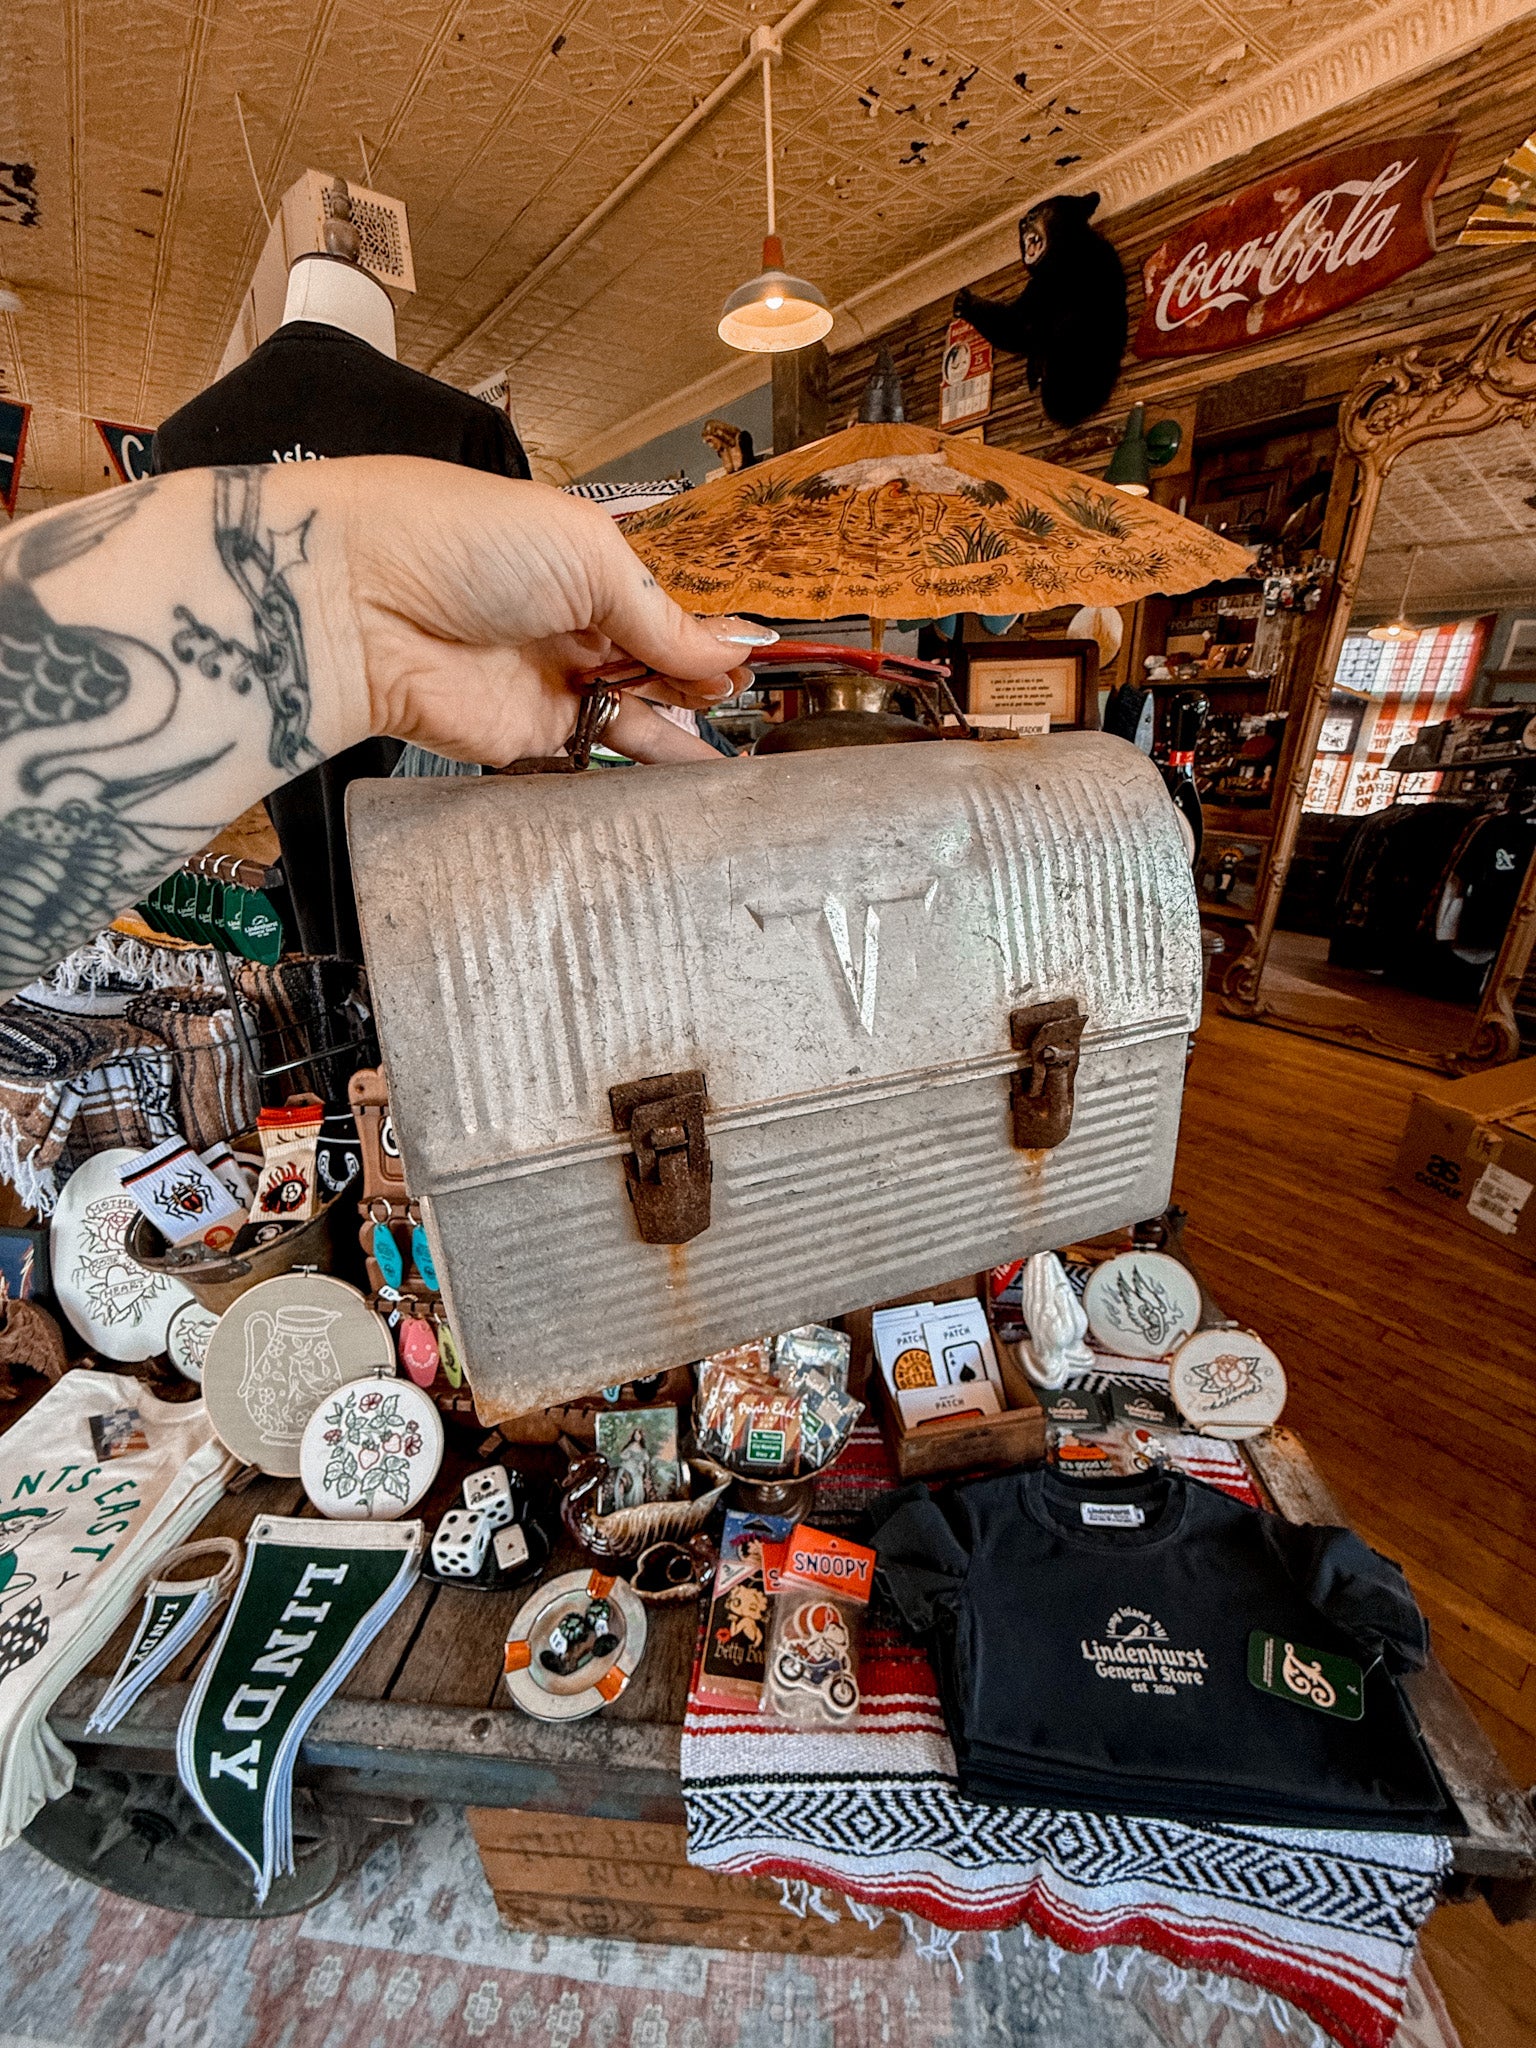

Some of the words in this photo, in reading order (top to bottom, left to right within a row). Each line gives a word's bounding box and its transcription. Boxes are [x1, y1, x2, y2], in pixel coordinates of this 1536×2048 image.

[1155, 157, 1419, 331] Coca-Cola
[91, 1199, 139, 1216] MOTHE
[104, 1281, 144, 1298] HEART
[943, 1326, 970, 1339] PATCH
[900, 1371, 931, 1389] BETTE
[738, 1401, 769, 1415] Points
[771, 1401, 797, 1420] East
[935, 1398, 965, 1410] PATCH
[71, 1479, 141, 1562] EAST
[793, 1550, 869, 1580] SNOOPY
[133, 1601, 180, 1664] LINDY
[1105, 1612, 1124, 1635] Long
[1117, 1605, 1152, 1624] Island
[714, 1640, 745, 1667] Betty
[1081, 1640, 1209, 1669] Lindenhurst
[210, 1563, 349, 1790] LINDY
[1095, 1662, 1158, 1683] General
[1159, 1665, 1204, 1686] Store
[1131, 1682, 1150, 1694] est
